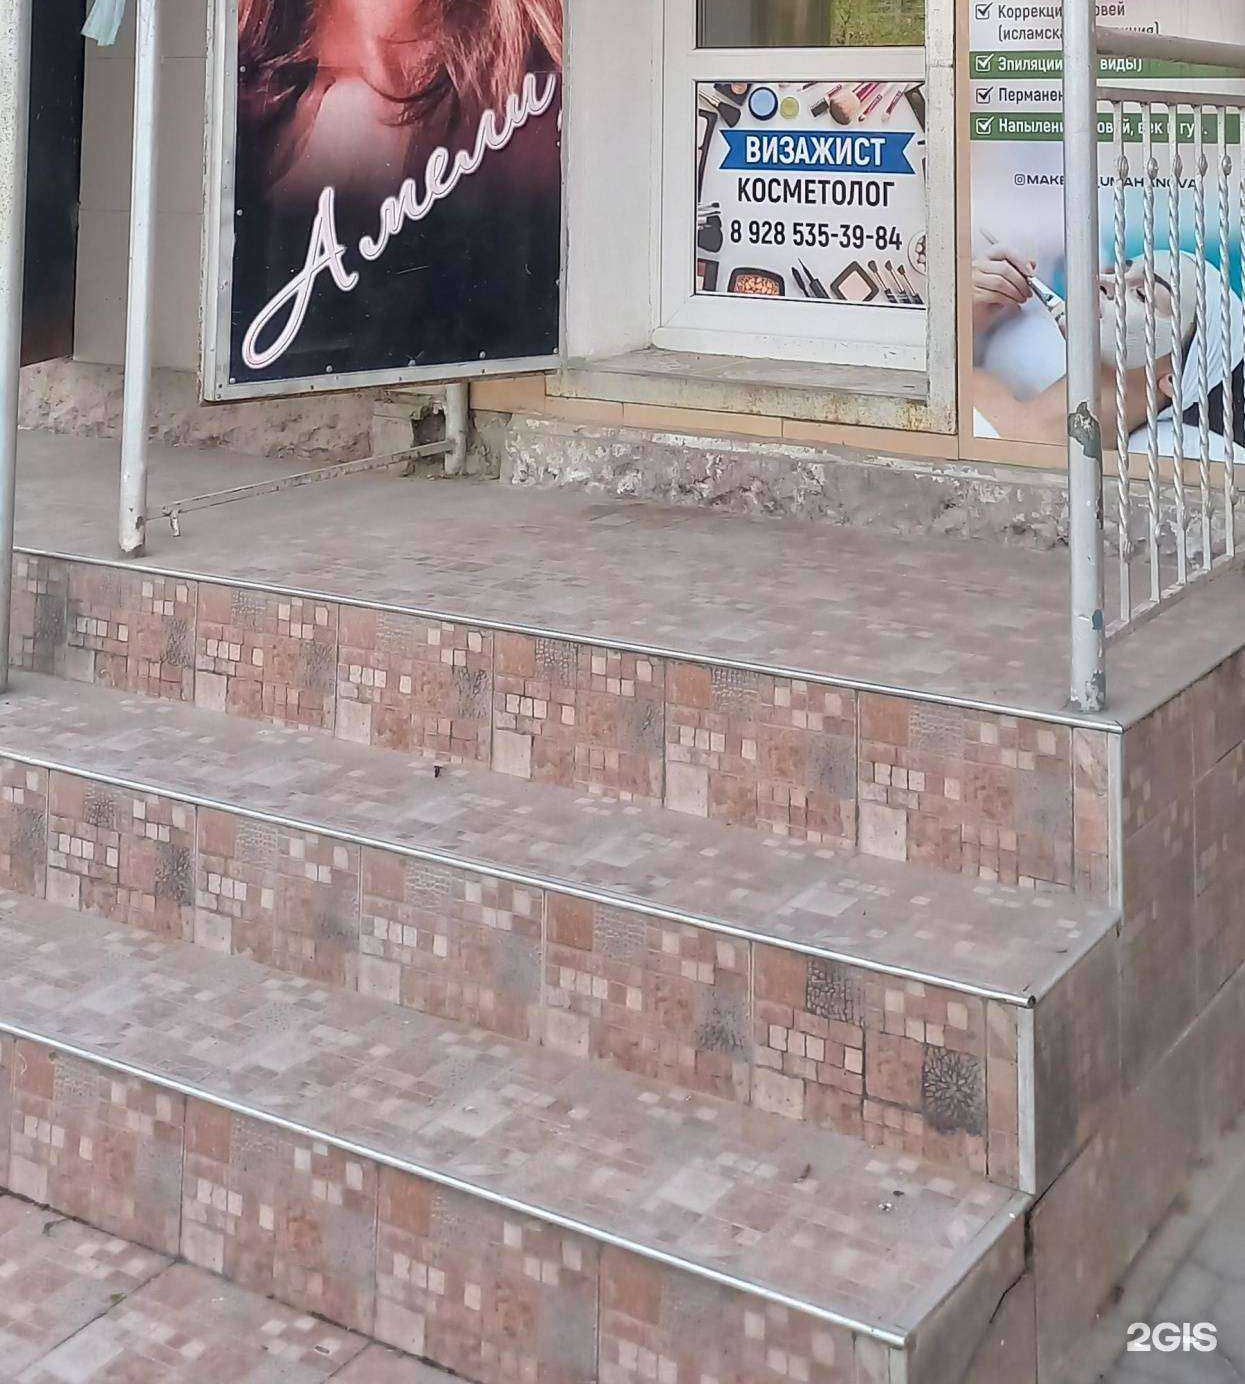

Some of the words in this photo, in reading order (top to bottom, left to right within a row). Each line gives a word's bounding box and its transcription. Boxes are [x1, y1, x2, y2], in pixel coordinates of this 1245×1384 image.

[998, 4, 1062, 21] Коррекци
[1095, 2, 1125, 17] овей
[998, 57, 1063, 74] Эпиляции
[999, 118, 1064, 134] Напылени
[1180, 122, 1208, 137] гу.
[746, 135, 886, 166] ВИЗАЖИСТ
[738, 177, 895, 207] КОСМЕТОЛОГ
[242, 73, 556, 369] Амели
[730, 219, 742, 243] 8
[749, 220, 786, 245] 928
[793, 222, 902, 250] 535-39-84
